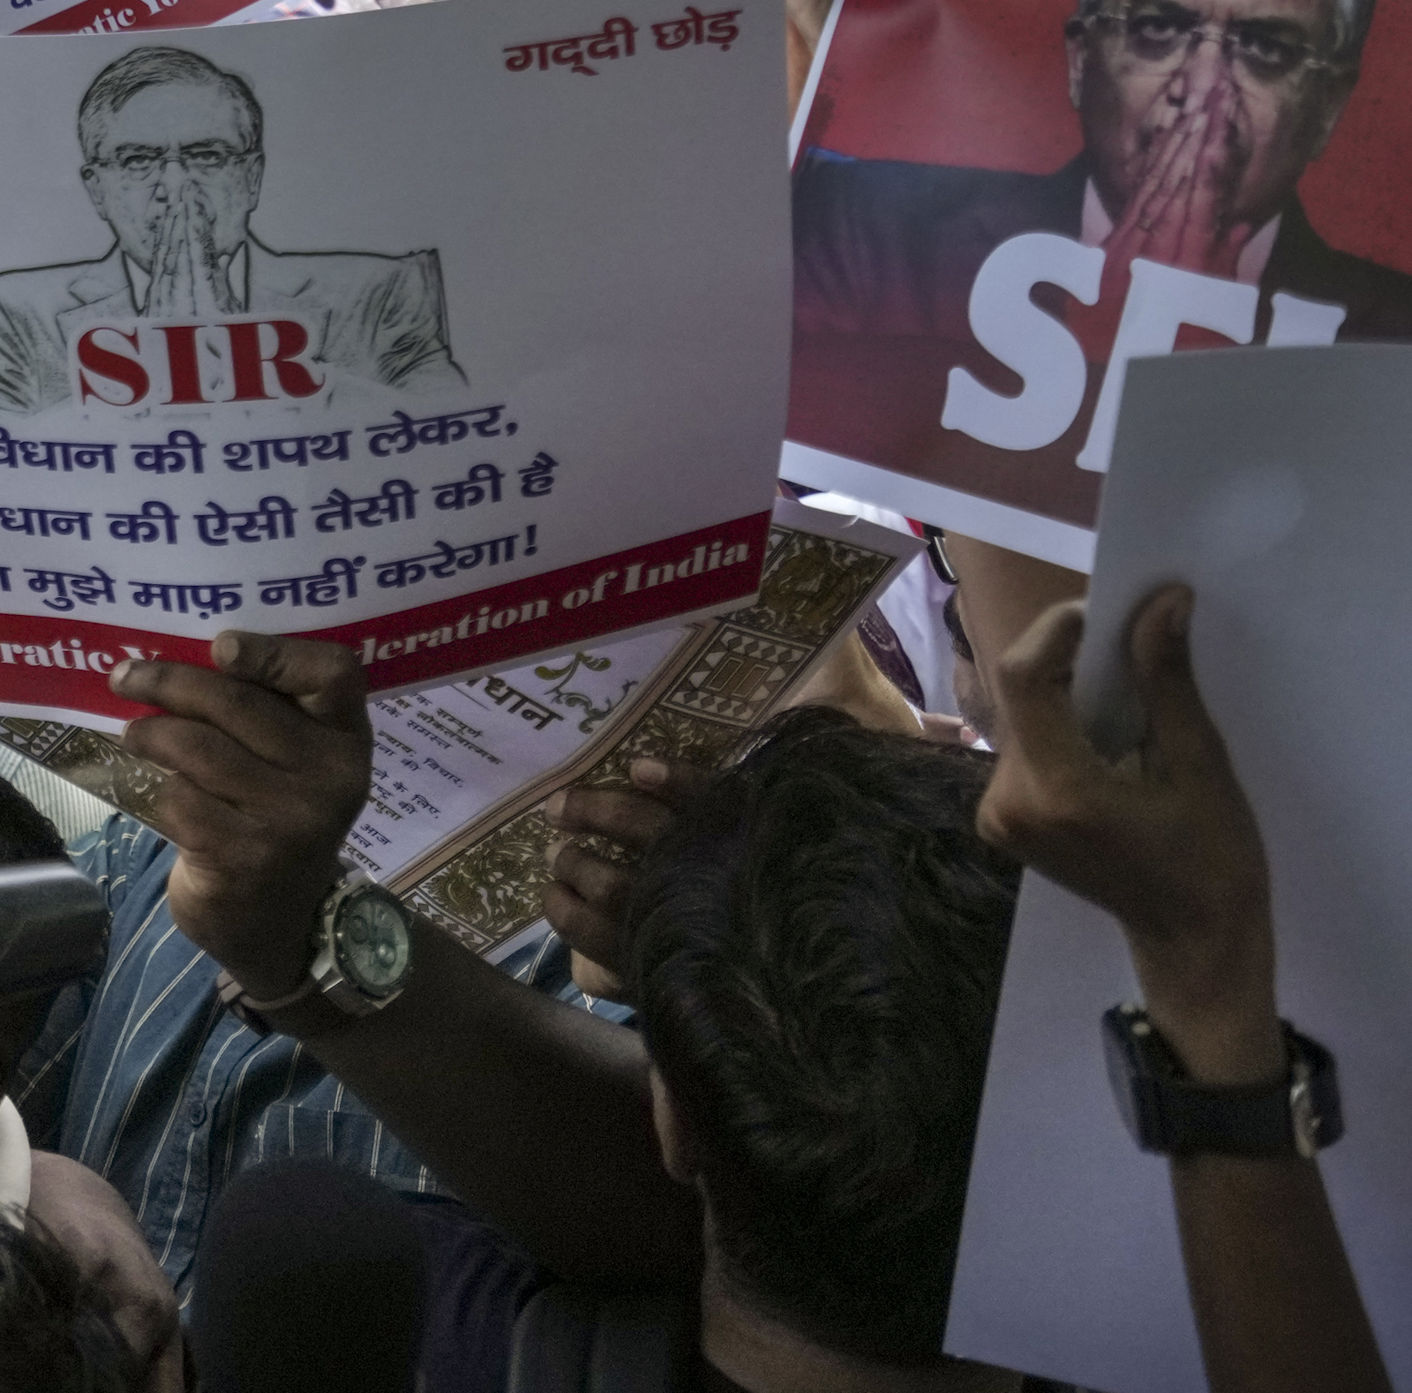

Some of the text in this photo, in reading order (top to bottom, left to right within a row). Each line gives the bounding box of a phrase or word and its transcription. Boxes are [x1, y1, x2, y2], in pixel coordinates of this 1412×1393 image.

[501, 4, 744, 78] गद्दी छोड़
[76, 318, 326, 408] SIR
[940, 229, 1348, 475] SF
[129, 429, 208, 475] की
[221, 428, 353, 474] शपथ
[364, 403, 520, 458] लेकर,
[104, 500, 181, 546] की
[192, 494, 299, 547] ऐसी
[310, 477, 421, 535] तैसी
[430, 462, 507, 513] की
[517, 450, 560, 499] है
[22, 565, 118, 613] मुझे
[127, 580, 244, 621] माफ़
[256, 554, 369, 609] नहीं
[373, 522, 540, 590] करेगा!
[562, 569, 620, 612] of
[619, 536, 751, 596] India
